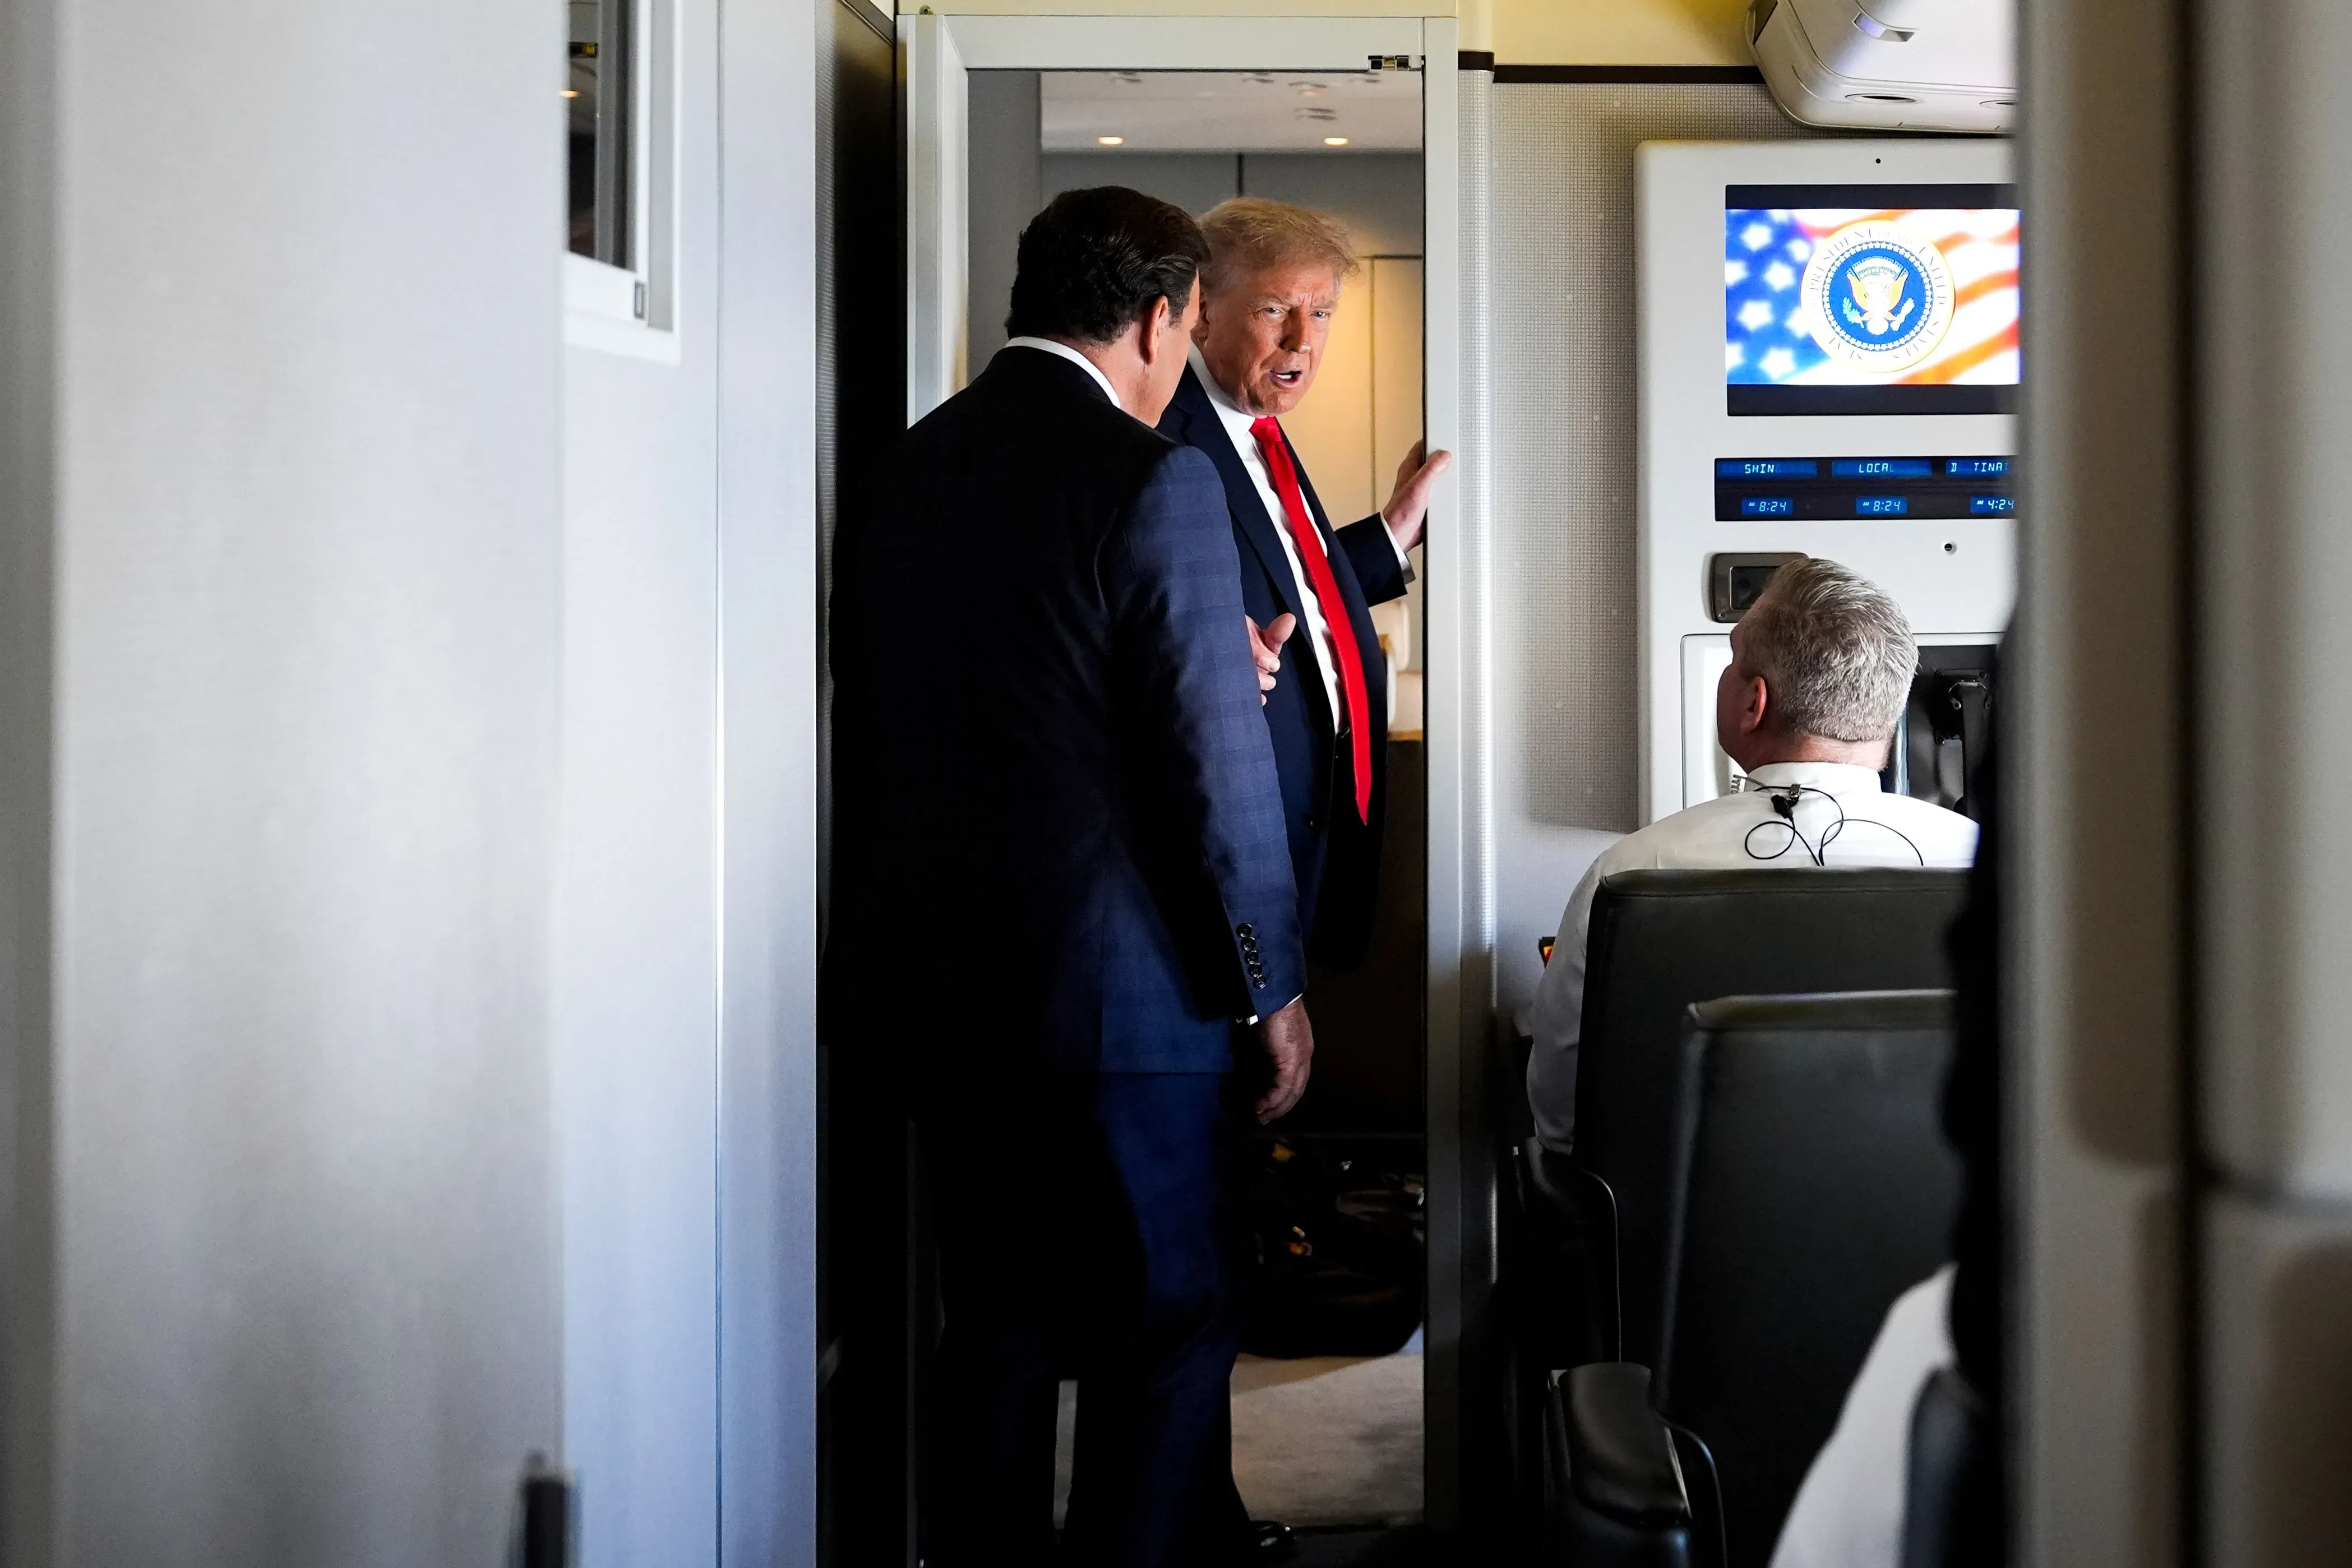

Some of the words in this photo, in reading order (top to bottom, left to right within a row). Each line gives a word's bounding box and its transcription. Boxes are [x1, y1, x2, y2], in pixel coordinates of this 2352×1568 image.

[1759, 501, 1787, 512] 8:24
[1873, 501, 1901, 511] 8:24
[1988, 499, 2014, 510] 4:24
